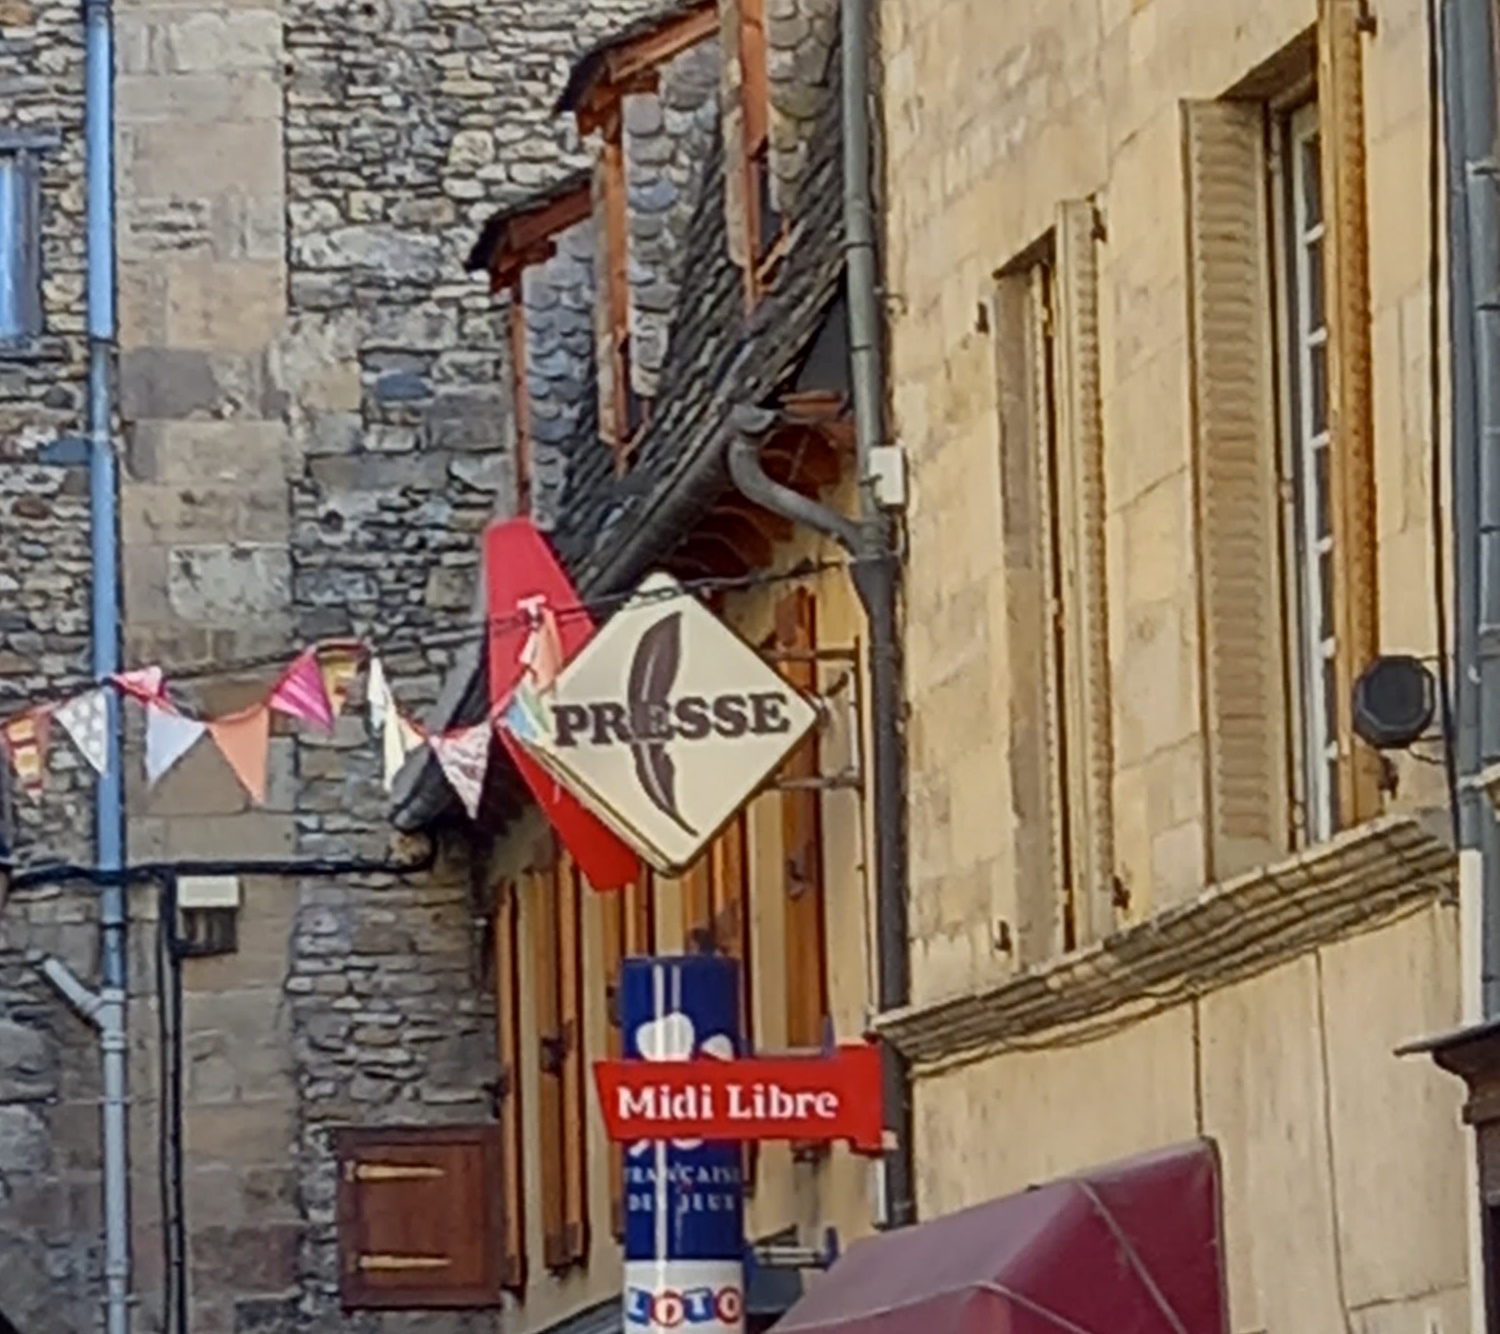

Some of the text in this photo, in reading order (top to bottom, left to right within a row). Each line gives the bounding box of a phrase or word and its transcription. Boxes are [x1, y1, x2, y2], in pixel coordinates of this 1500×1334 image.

[550, 691, 791, 748] PRESSE
[616, 1081, 840, 1120] Midi Libre
[627, 1286, 743, 1327] LOTO
